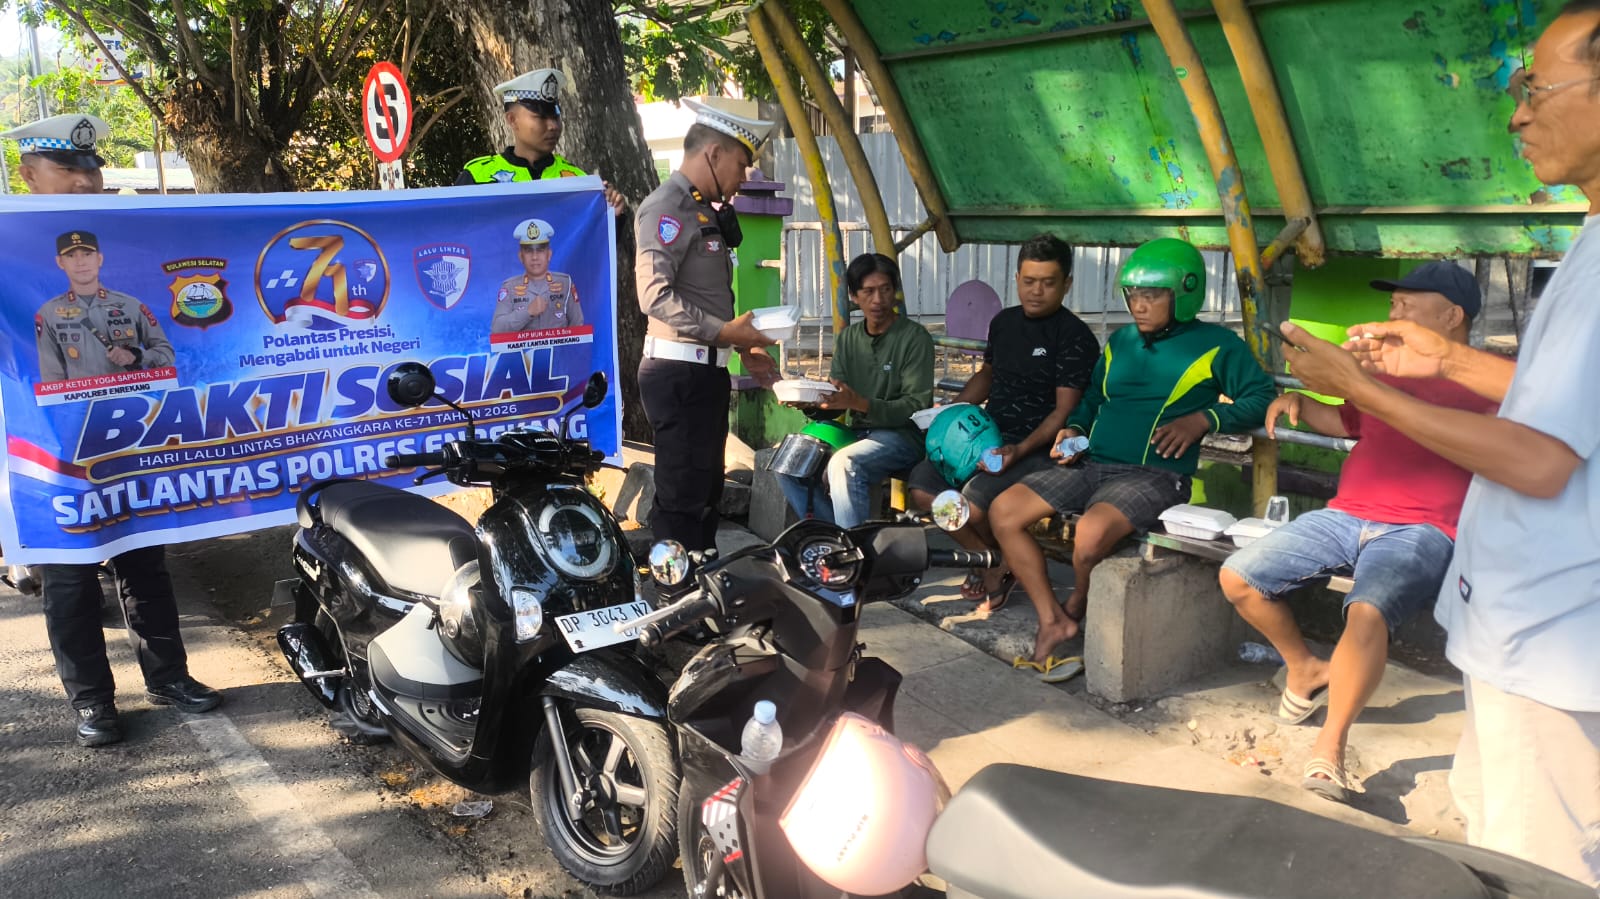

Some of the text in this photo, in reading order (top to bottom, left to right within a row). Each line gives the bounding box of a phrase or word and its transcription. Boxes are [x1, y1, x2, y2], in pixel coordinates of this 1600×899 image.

[374, 84, 399, 139] S
[418, 246, 465, 257] LALU LINTAS
[166, 259, 225, 271] SULAWESI SELATAN
[262, 324, 396, 349] Polantas Presisi,
[527, 339, 549, 347] LANTAS
[549, 336, 580, 346] ENREKANG
[239, 337, 421, 367] Mengabdi untuk Negeri
[40, 369, 173, 392] AKBP KETUT YOGA SAPUTRA, S.I.K.
[64, 383, 151, 401] KAPOLRES ENREKANG
[75, 370, 327, 462] BAKTI
[139, 452, 179, 467] HARI
[184, 447, 226, 462] LALU
[231, 438, 282, 456] LINTAS
[286, 421, 391, 446] BHAYANGKARA
[395, 412, 432, 429] KE-71
[484, 404, 518, 417] 2026
[52, 461, 280, 525] SATLANTAS
[286, 438, 416, 487] POLRES
[560, 616, 581, 633] DP
[587, 607, 628, 627] 3043
